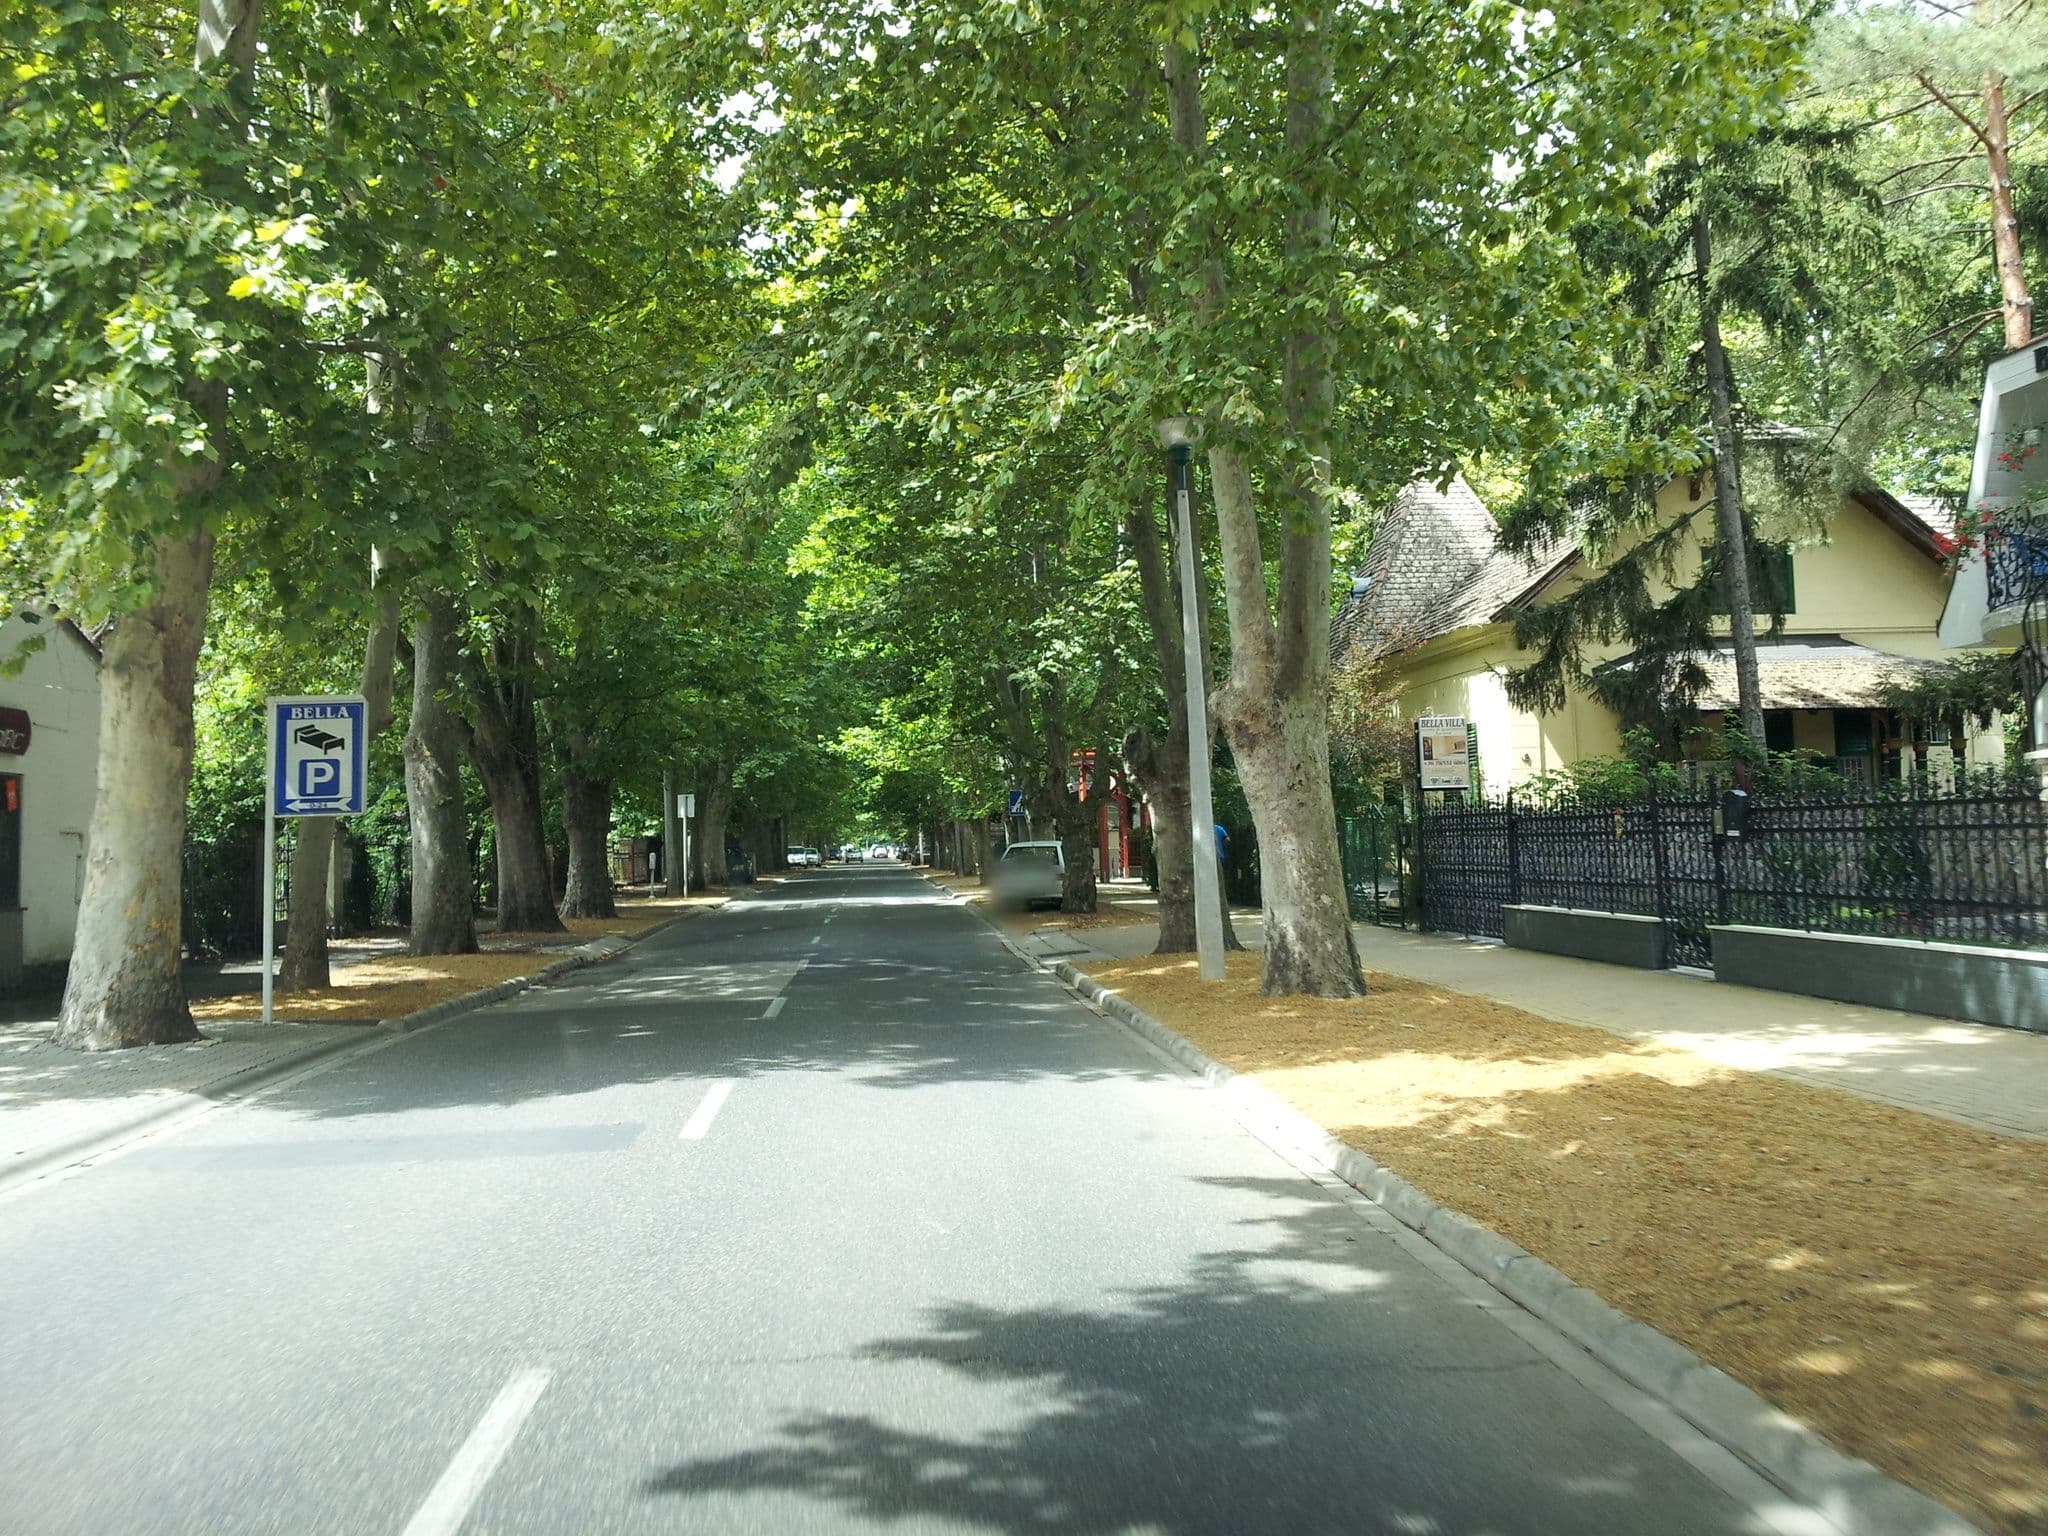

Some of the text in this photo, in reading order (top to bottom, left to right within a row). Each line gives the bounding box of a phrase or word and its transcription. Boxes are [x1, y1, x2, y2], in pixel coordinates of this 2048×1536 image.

[291, 706, 349, 719] BELLA
[1421, 718, 1465, 728] BELLA VILLA
[306, 761, 334, 794] P
